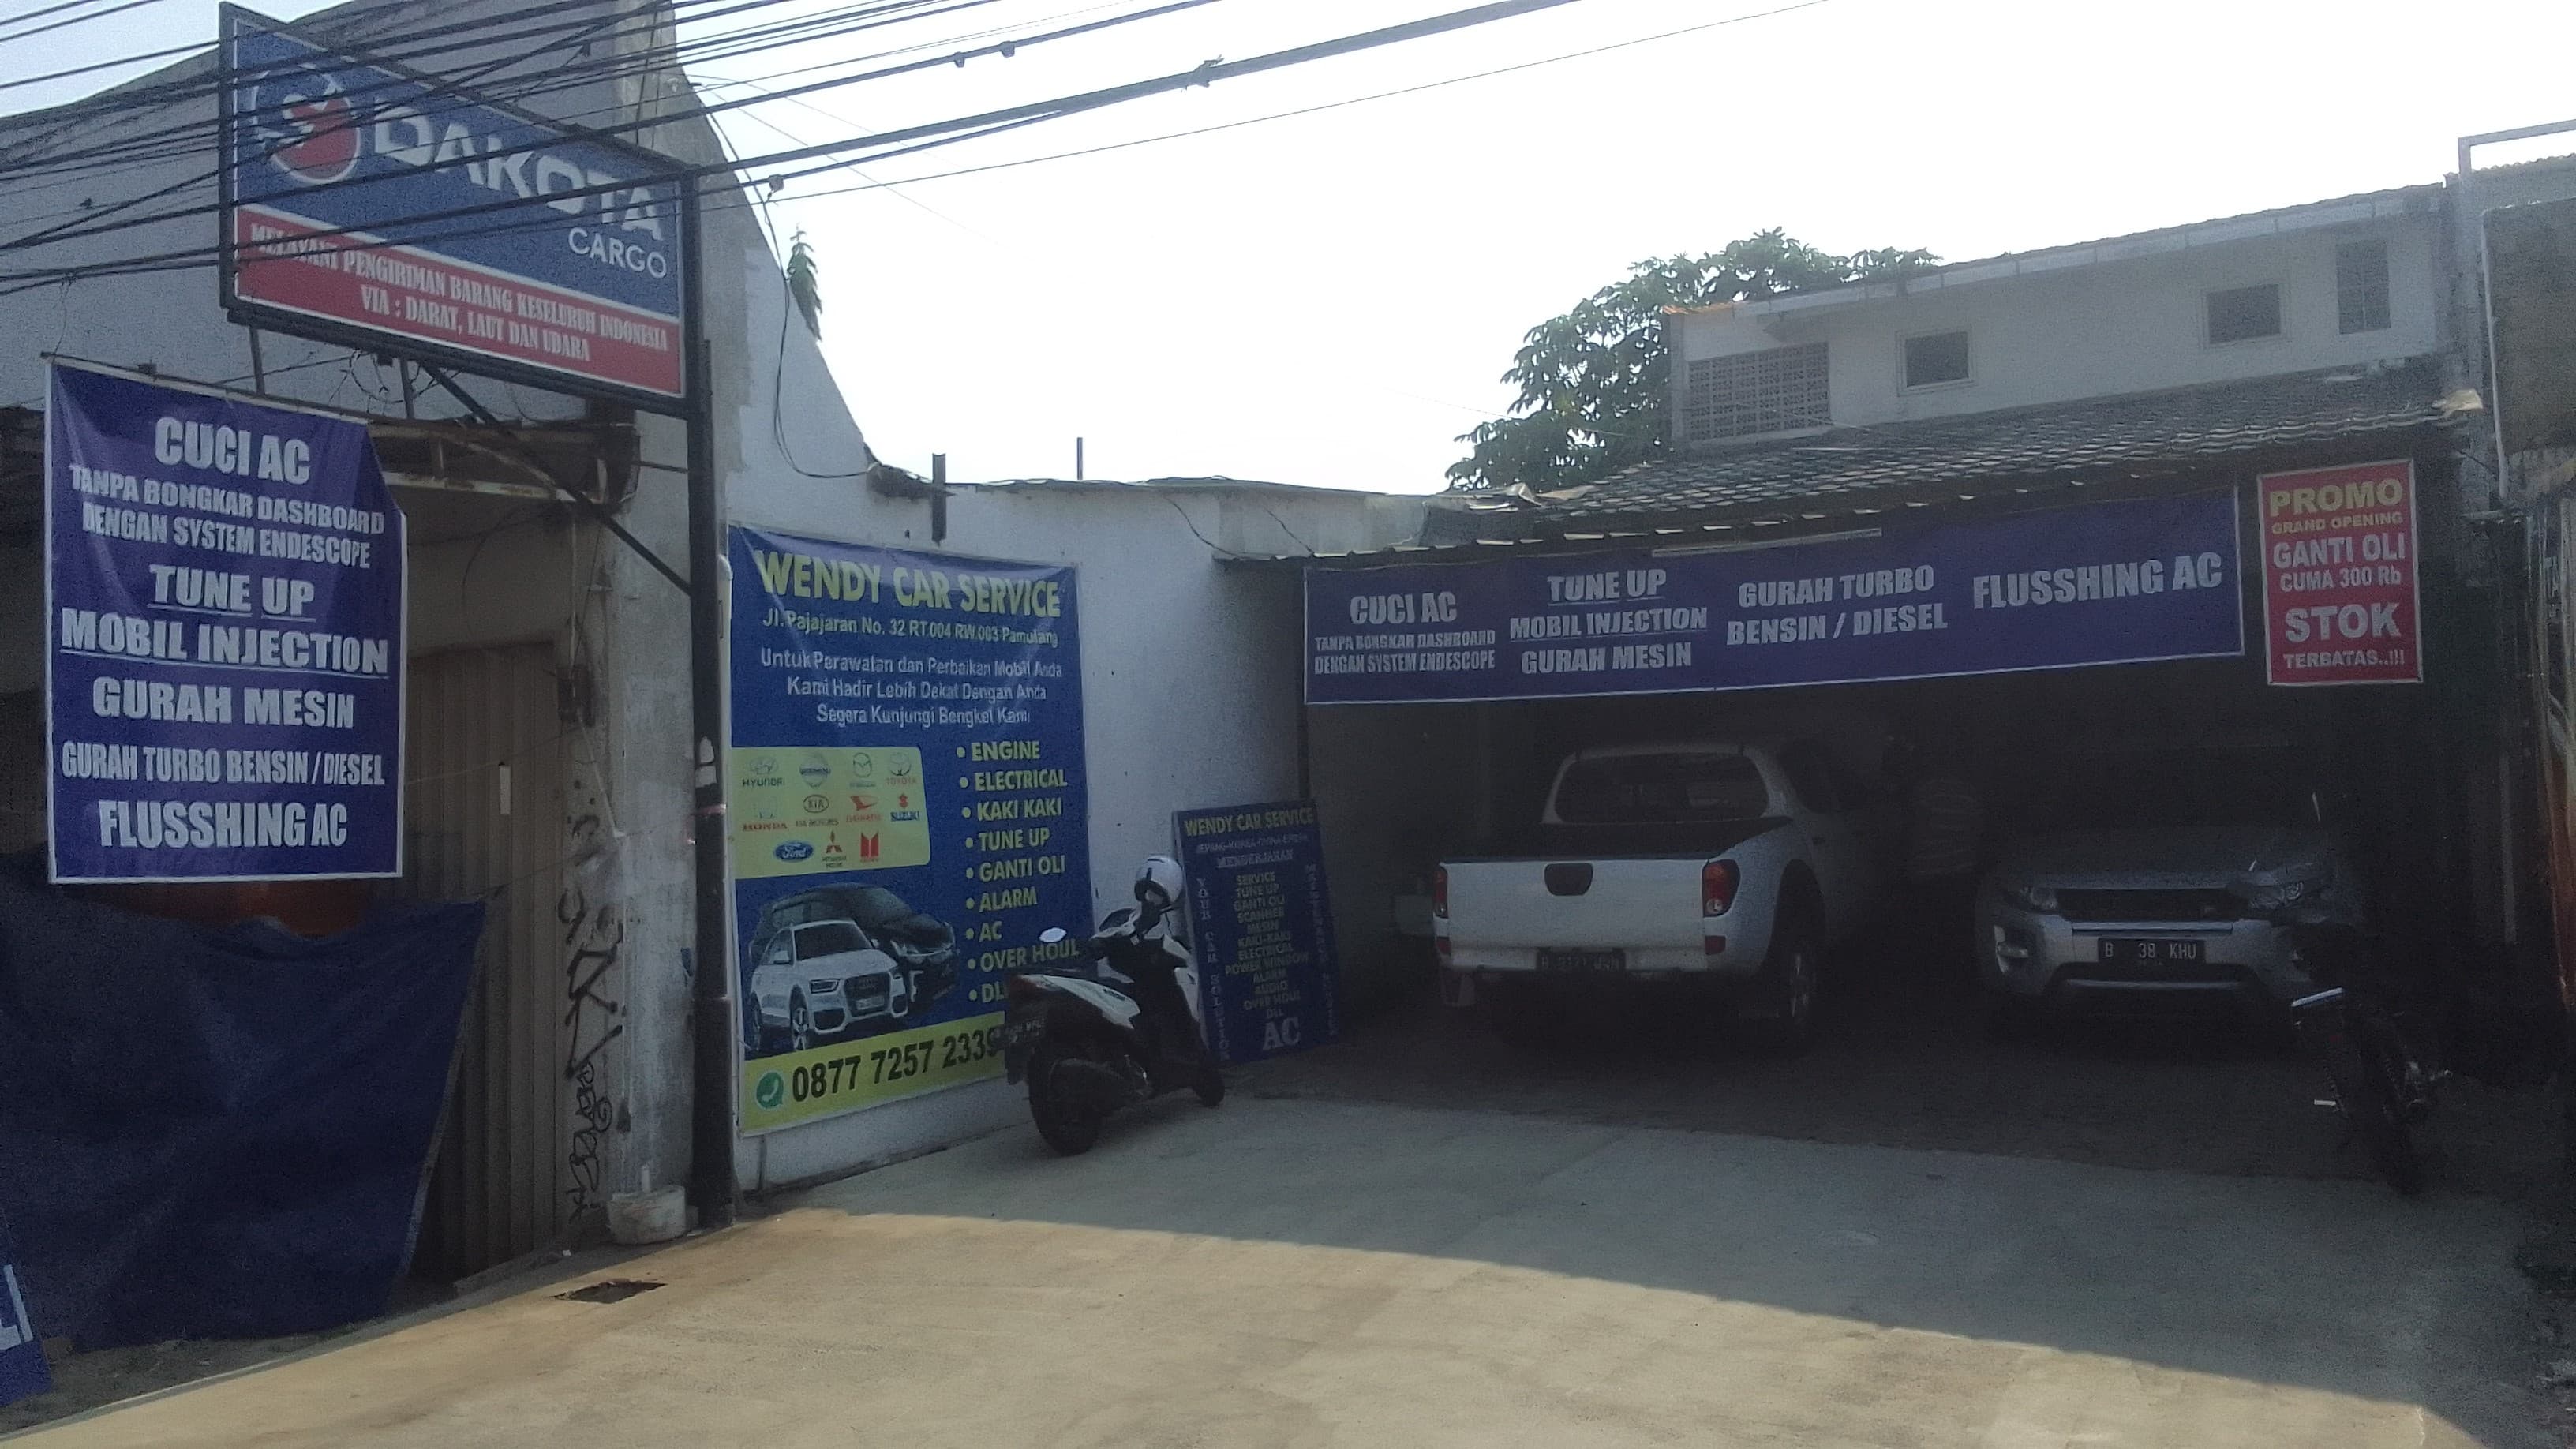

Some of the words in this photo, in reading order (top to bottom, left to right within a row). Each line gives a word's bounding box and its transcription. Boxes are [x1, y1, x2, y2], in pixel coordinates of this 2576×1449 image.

[374, 98, 664, 241] DAKOTA
[568, 227, 667, 279] CARGO
[343, 249, 445, 298] PENGIRIMAN
[450, 276, 512, 312] BARANG
[517, 291, 597, 333] KESELURUH
[600, 313, 668, 352] INDONESIA
[360, 286, 391, 316] VIA
[466, 309, 507, 343] LAUT
[509, 317, 541, 351] DAN
[542, 324, 590, 362] UDARA
[154, 416, 250, 477] CUCI
[257, 434, 311, 485] AC
[69, 463, 140, 503] TAMPA
[144, 477, 253, 520] BONGKAR
[256, 495, 385, 535] DASHBOARD
[2269, 477, 2404, 518] PROMO
[82, 501, 168, 544] DENGAN
[173, 516, 255, 555] SYSTEM
[260, 528, 371, 569] ENDESCOPE
[2271, 517, 2327, 535] GRAND
[2331, 511, 2404, 530] OPENING
[2272, 535, 2354, 570] GANTI
[2361, 532, 2406, 562] OLI
[149, 563, 252, 613] TUNE
[261, 576, 315, 616] UP
[752, 549, 881, 604] WENDY
[893, 567, 953, 611] CAR
[958, 572, 1061, 619] SERVICE
[1547, 572, 1621, 602] TUNE
[1626, 568, 1667, 599] UP
[1738, 576, 1833, 608] GURAH
[1840, 564, 1935, 598] TURBO
[1972, 558, 2165, 610] FLUSSHING
[2171, 551, 2223, 592] AC
[2279, 569, 2335, 593] CUMA
[2339, 566, 2373, 589] 300
[2377, 564, 2402, 586] Rb
[788, 609, 857, 636] Pajajaran
[861, 616, 886, 635] No.
[889, 618, 906, 635] 32
[1349, 593, 1416, 625] CUCI
[1421, 591, 1458, 623] AC
[1509, 613, 1582, 642] MOBIL
[1586, 606, 1707, 636] INJECTION
[1725, 615, 1827, 646] BENSIN
[1831, 612, 1848, 640] /
[1852, 602, 1949, 636] DIESEL
[2284, 601, 2402, 643] STOK
[61, 606, 188, 661] MOBIL
[197, 623, 389, 675] INJECTION
[1314, 635, 1354, 652] TAMPA
[1356, 633, 1416, 650] BONGKAR
[1417, 630, 1496, 648] DASHBOARD
[760, 646, 812, 669] Untuk
[814, 650, 893, 674] Perawatan
[898, 655, 924, 674] dan
[927, 657, 992, 677] Perbaikan
[994, 660, 1032, 677] Mobil
[1034, 661, 1063, 679] Anda
[1314, 655, 1365, 676] DENGAN
[1367, 652, 1417, 674] SYSTEM
[1419, 649, 1496, 672] ENDESCOPE
[1520, 648, 1607, 676] GURAH
[1611, 642, 1693, 671] MESIN
[92, 676, 233, 724] GURAH
[243, 687, 354, 729] MESIN
[787, 676, 830, 696] Kami
[833, 679, 873, 699] Hadir
[876, 682, 917, 700] Lebih
[920, 683, 959, 700] Dekat
[962, 685, 1013, 703] Dengan
[1016, 684, 1046, 701] Anda
[816, 702, 867, 727] Segera
[871, 705, 936, 729] Kunjungi
[939, 707, 994, 729] Bengkel
[62, 739, 138, 781] GURAH
[143, 746, 221, 784] TURBO
[226, 749, 309, 785] BENSIN
[323, 752, 386, 787] DIESEL
[971, 740, 1041, 762] ENGINE
[974, 769, 1069, 792] ELECTRICAL
[98, 799, 307, 848] FLUSSHING
[310, 802, 348, 848] AC
[976, 799, 1019, 822] KAKI
[1023, 797, 1063, 818] KAKI
[1184, 818, 1234, 837] WENDY
[1237, 812, 1262, 833] CAR
[1265, 807, 1314, 828] SERVICE
[978, 829, 1024, 852] TUNE
[1028, 826, 1051, 848] UP
[979, 858, 1033, 883] GANTI
[1037, 854, 1066, 876] OLI
[978, 886, 1039, 913] ALARM
[978, 920, 1003, 942] AC
[979, 946, 1028, 973] OVER
[1031, 938, 1080, 965] HOUL
[2105, 942, 2114, 957] B
[2169, 942, 2197, 960] KHU
[1263, 1017, 1301, 1051] AC
[792, 1054, 863, 1103] 0877
[871, 1040, 935, 1085] 7257
